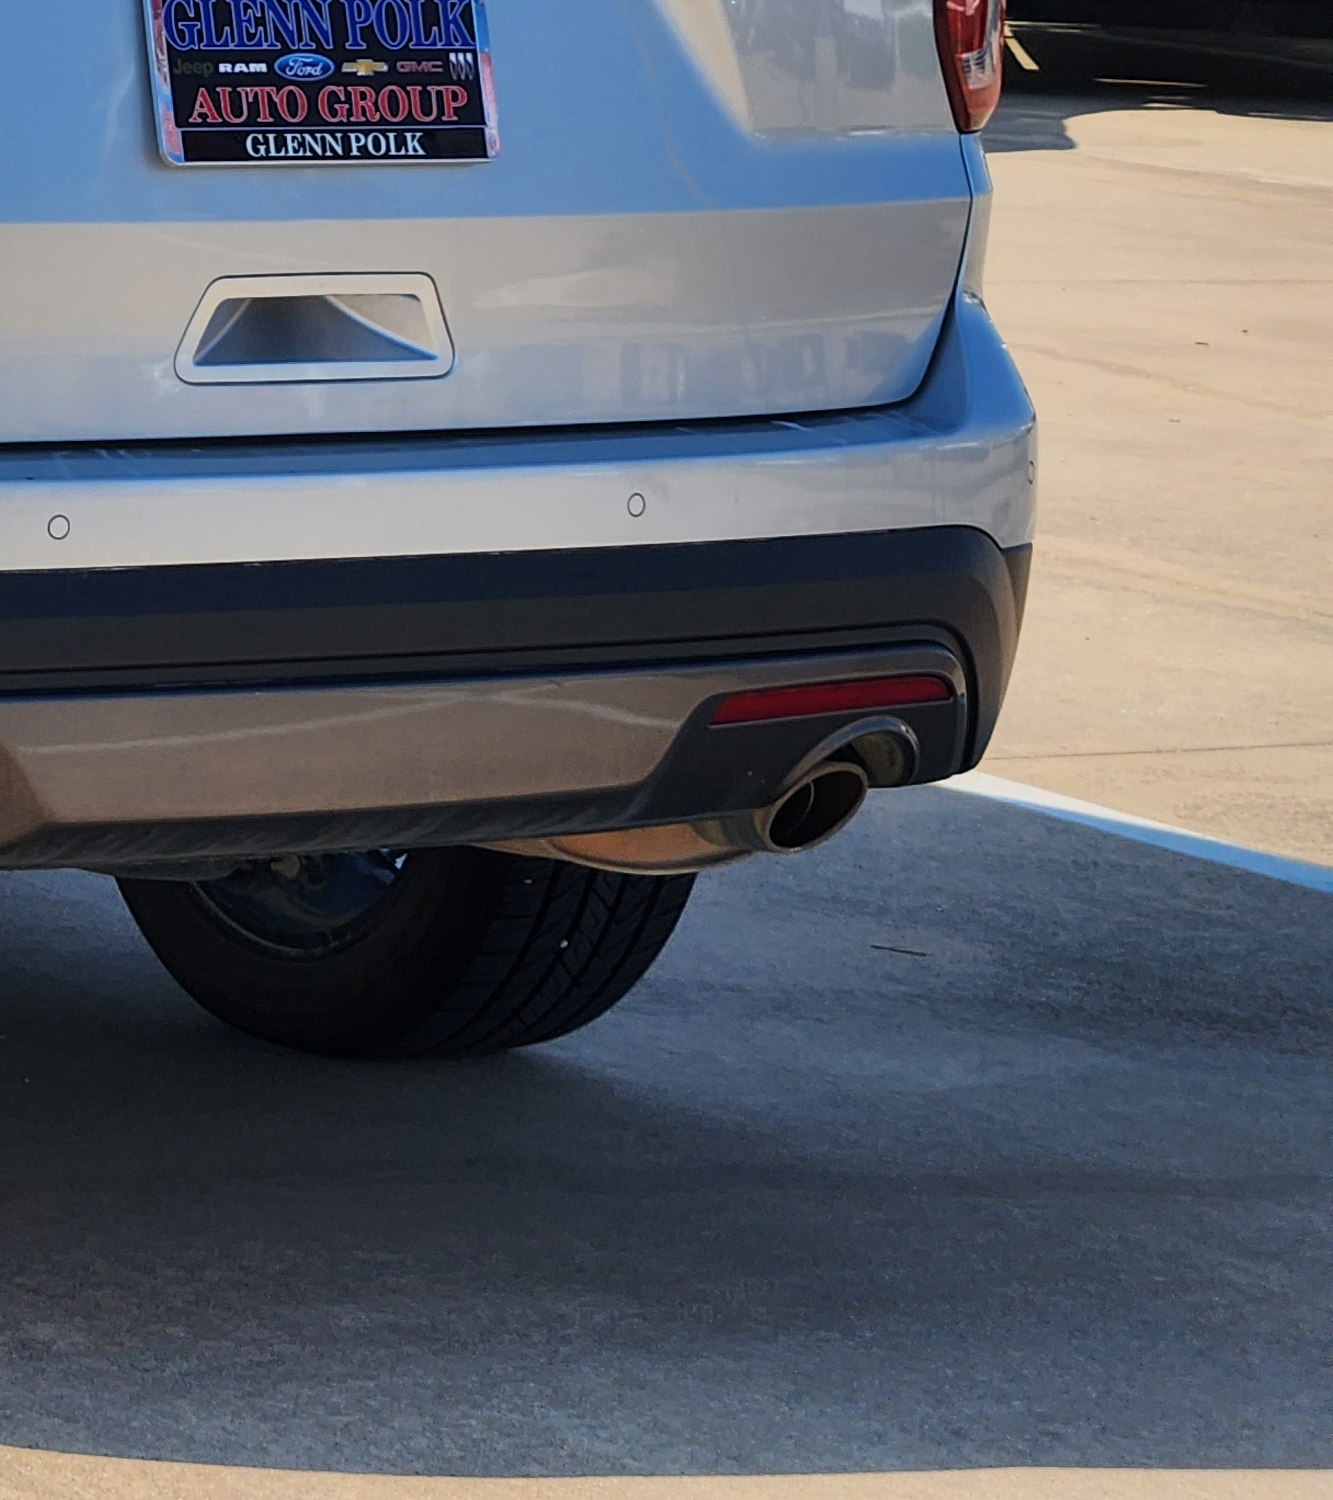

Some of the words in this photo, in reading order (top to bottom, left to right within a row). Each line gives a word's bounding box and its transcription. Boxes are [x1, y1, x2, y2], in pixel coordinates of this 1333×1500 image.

[173, 58, 213, 77] Jeep
[218, 62, 268, 74] RAM
[285, 56, 323, 77] Ford
[396, 61, 443, 73] GMC
[188, 85, 308, 123] AUTO
[318, 85, 469, 122] GROUP
[245, 132, 344, 157] GLENN
[347, 132, 427, 156] POLK
